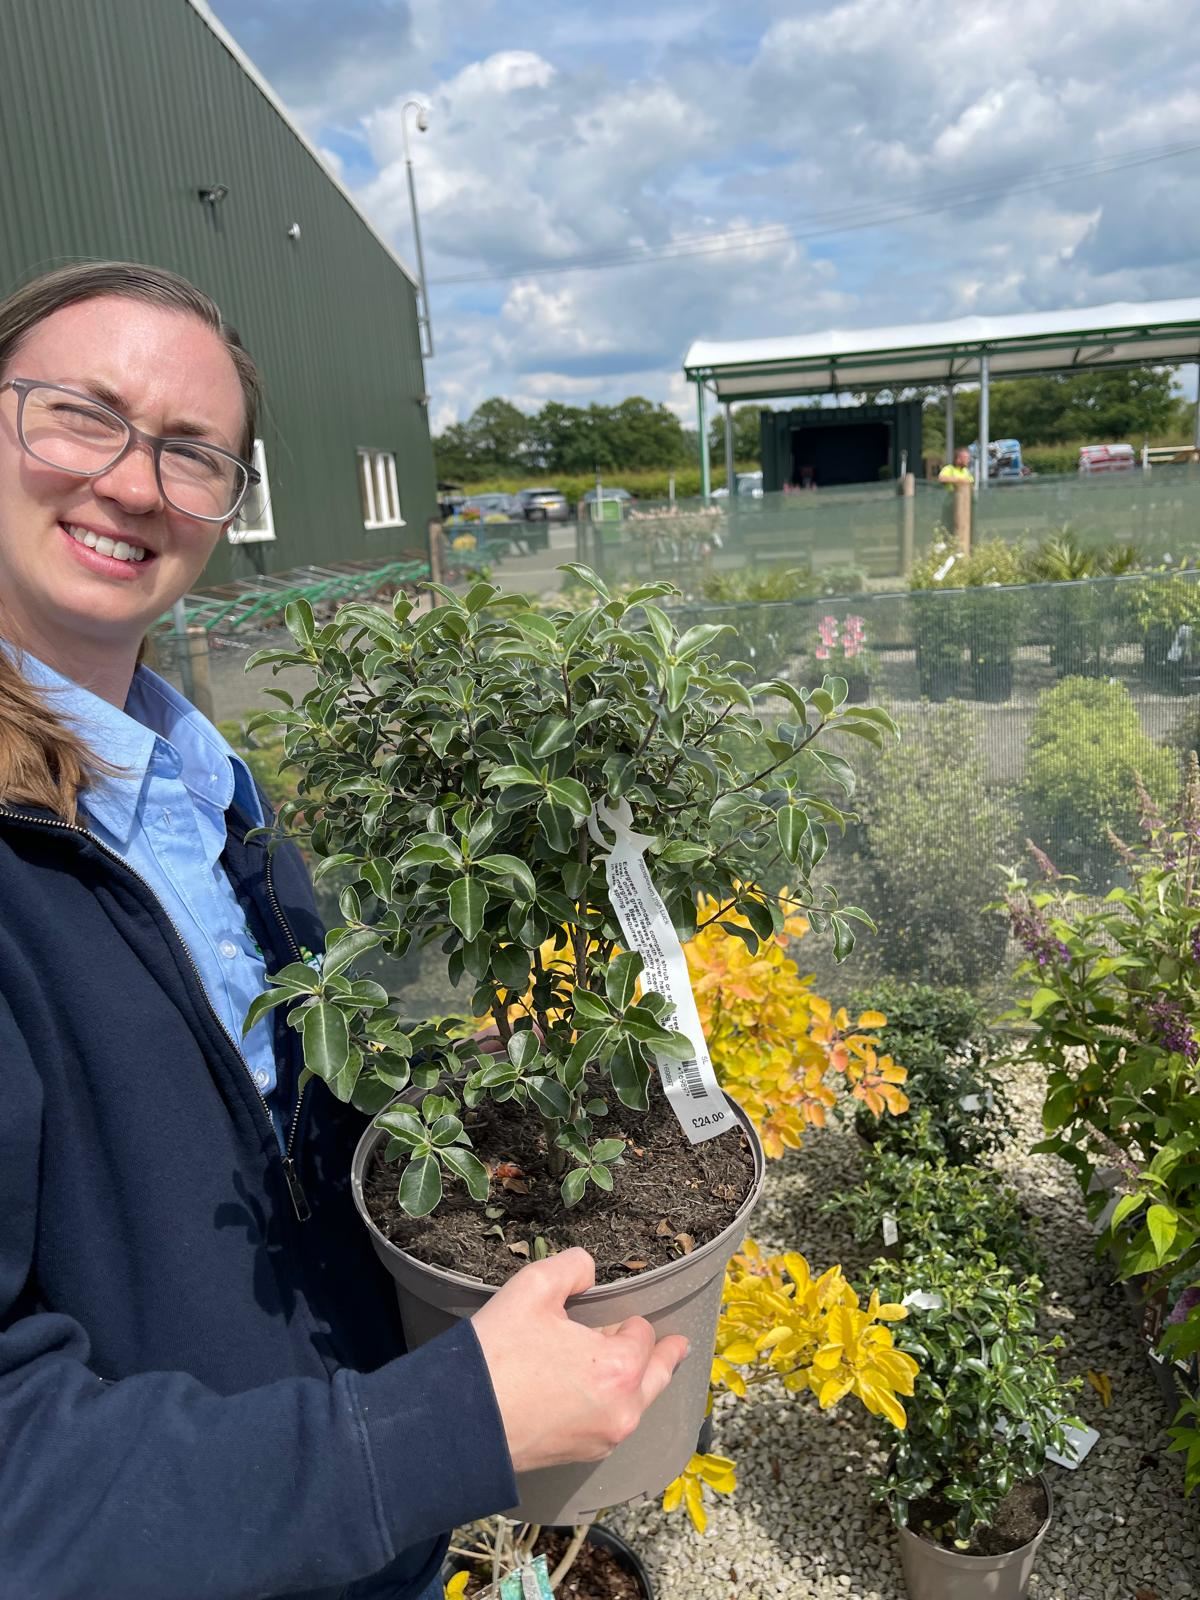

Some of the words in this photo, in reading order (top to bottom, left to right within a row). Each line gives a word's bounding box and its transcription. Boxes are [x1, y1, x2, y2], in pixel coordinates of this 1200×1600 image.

[614, 890, 626, 908] spring
[624, 913, 639, 943] Requires
[623, 862, 639, 897] Evergreen,
[650, 931, 665, 958] compact
[630, 899, 642, 917] green
[640, 919, 651, 941] leaves
[659, 910, 670, 925] Luck
[629, 909, 639, 928] Bears
[637, 931, 649, 948] small
[645, 950, 655, 970] honey
[692, 1112, 725, 1128] £24.00
